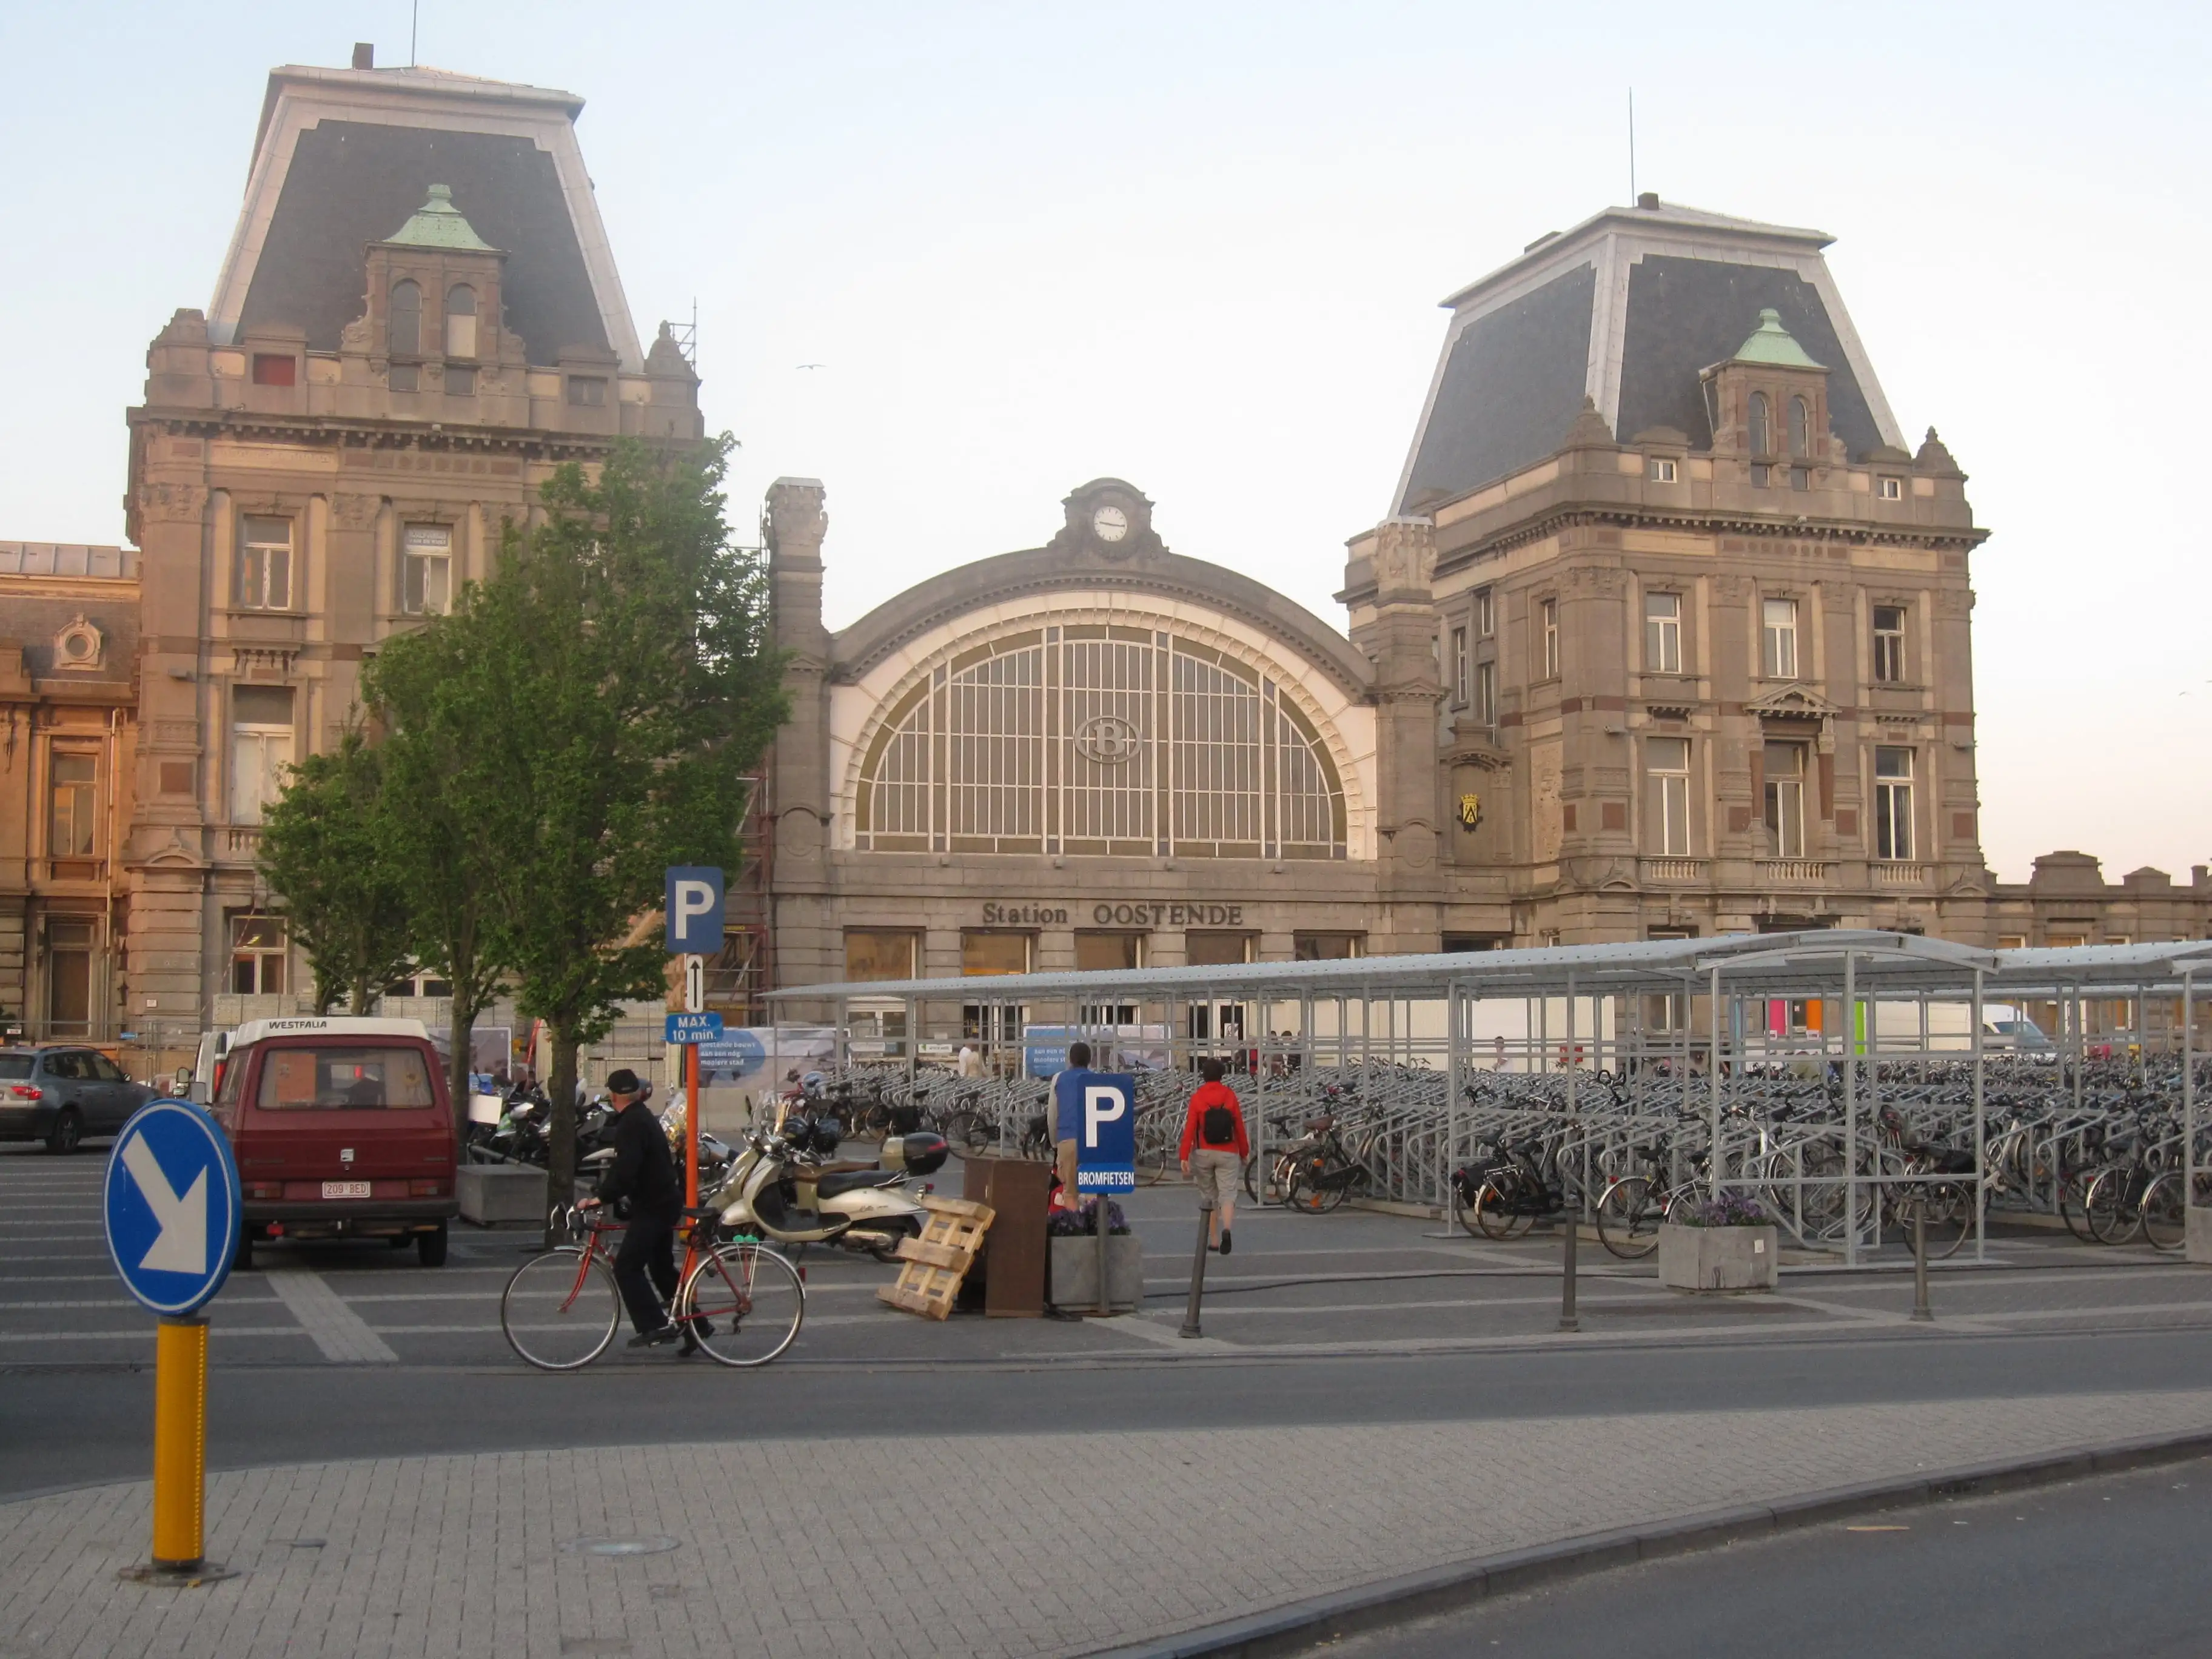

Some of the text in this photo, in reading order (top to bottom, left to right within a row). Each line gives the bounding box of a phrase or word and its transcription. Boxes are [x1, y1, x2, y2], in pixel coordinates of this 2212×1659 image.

[1094, 723, 1125, 756] B
[675, 880, 715, 939] P
[982, 903, 1243, 925] Station OOSTENDE
[678, 1015, 710, 1028] MAX.
[672, 1028, 716, 1041] 10 min.
[1085, 1087, 1125, 1147] P
[1078, 1172, 1134, 1185] BROMFIETSEN
[327, 1184, 366, 1194] 209 BED
